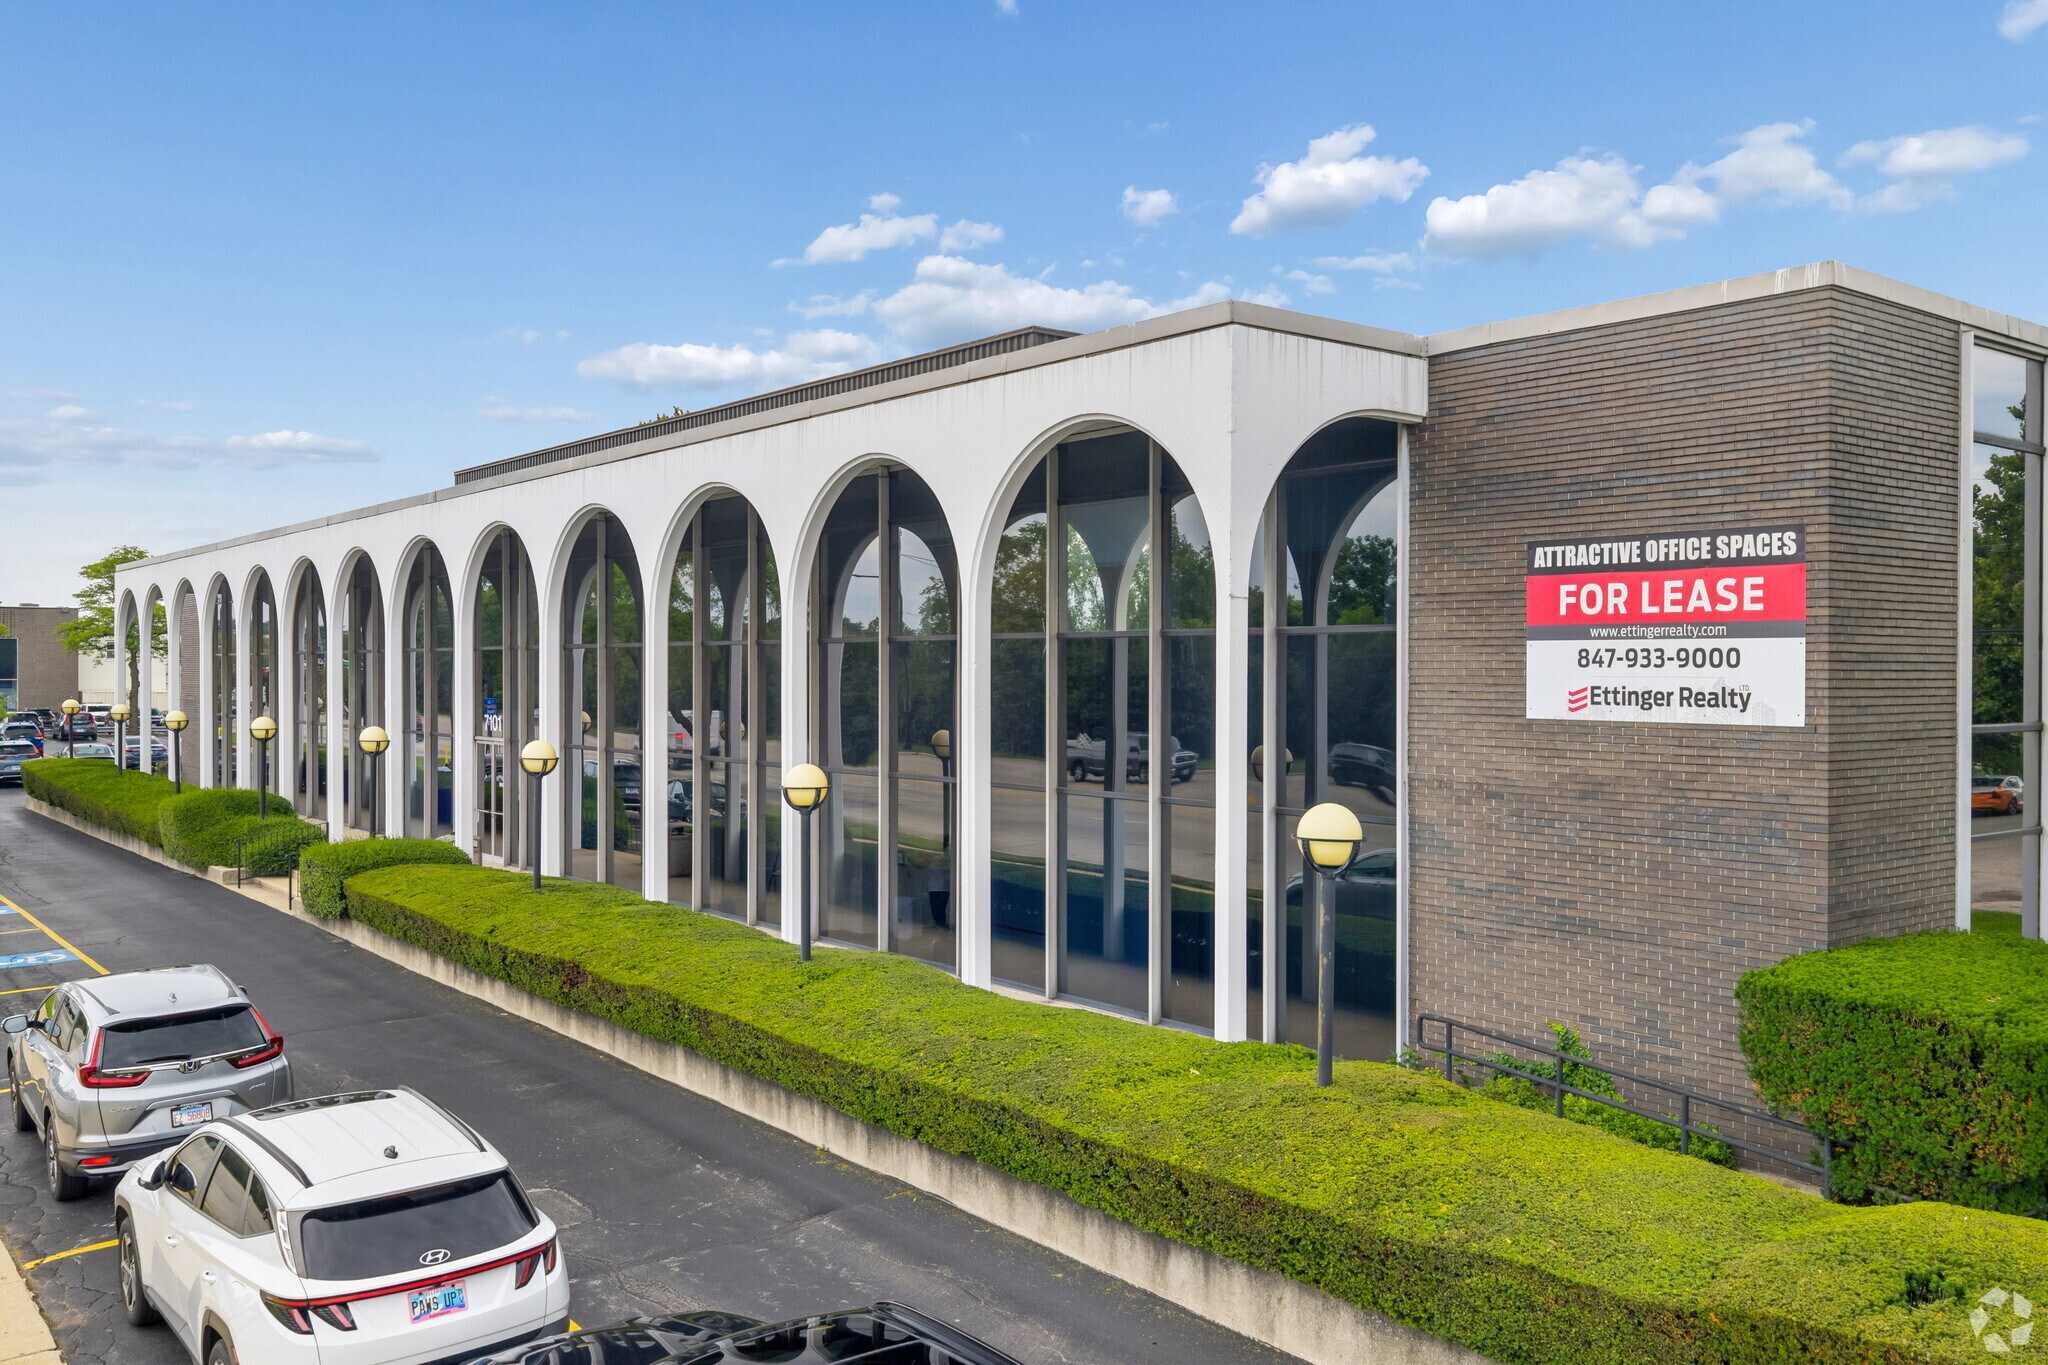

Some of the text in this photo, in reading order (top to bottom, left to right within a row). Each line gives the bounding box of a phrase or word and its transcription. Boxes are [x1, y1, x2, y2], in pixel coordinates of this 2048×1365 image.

[1534, 531, 1797, 568] ATTRACTIVE OFFICE SPACES
[1559, 576, 1764, 616] FOR LEASE
[1590, 624, 1727, 639] www.ettingerrealty.com
[1577, 647, 1741, 669] 847-933-9000
[1590, 685, 1752, 713] Ettinger Realty
[484, 714, 502, 731] 7101
[411, 1291, 457, 1316] PAWS UP
